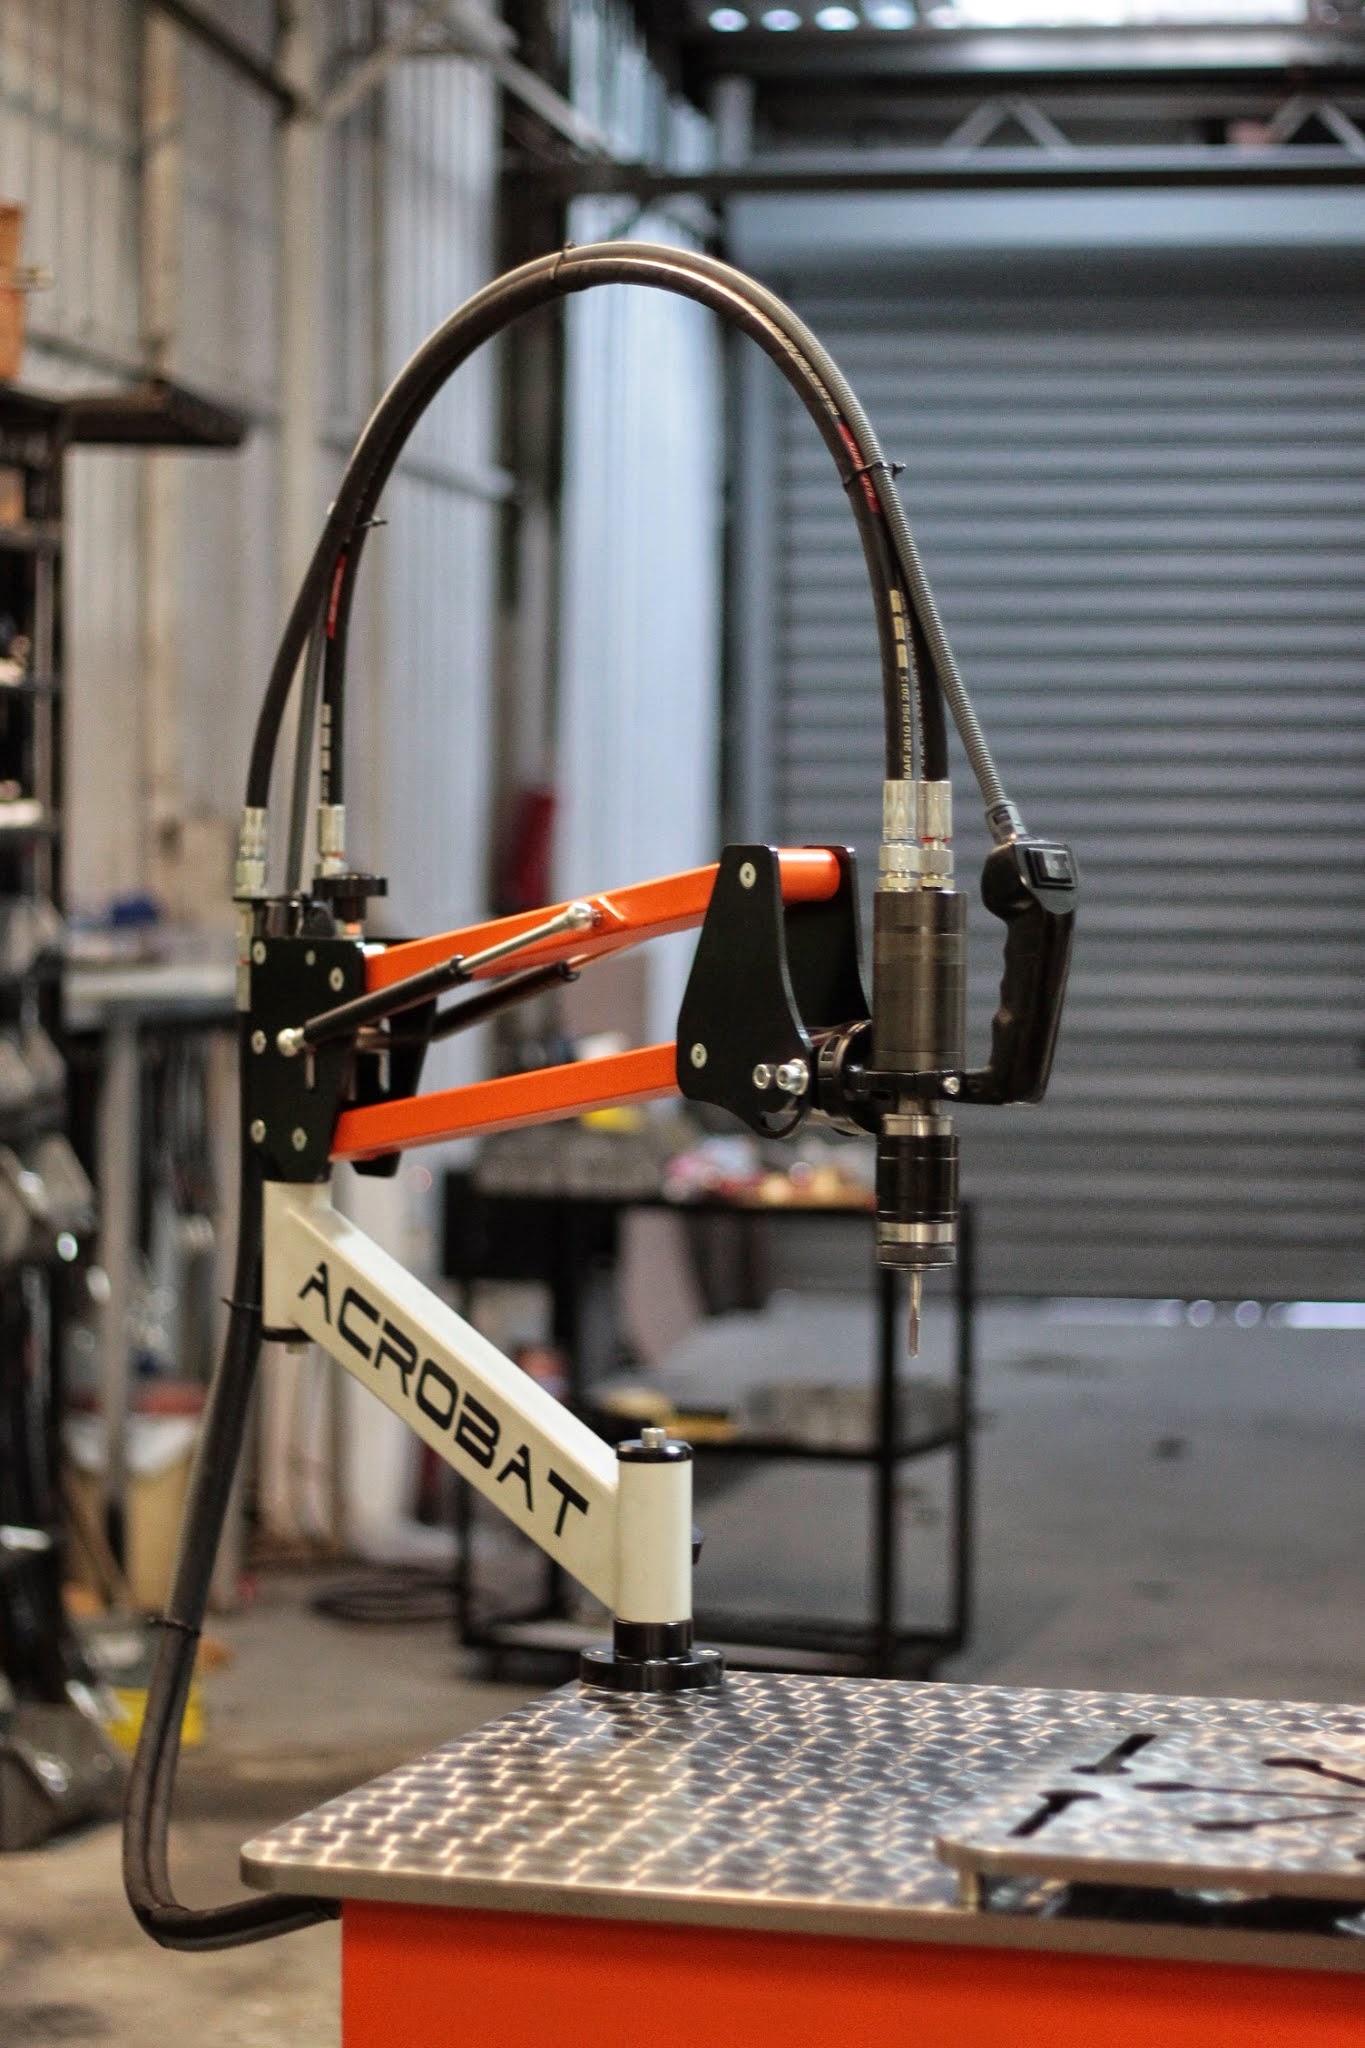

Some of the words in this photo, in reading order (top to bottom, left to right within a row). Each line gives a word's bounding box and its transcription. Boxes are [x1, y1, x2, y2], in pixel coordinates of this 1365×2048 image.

[901, 675, 911, 701] 2013
[902, 705, 911, 723] PSI
[903, 755, 912, 779] BAR
[298, 1261, 589, 1537] ACROBAT
